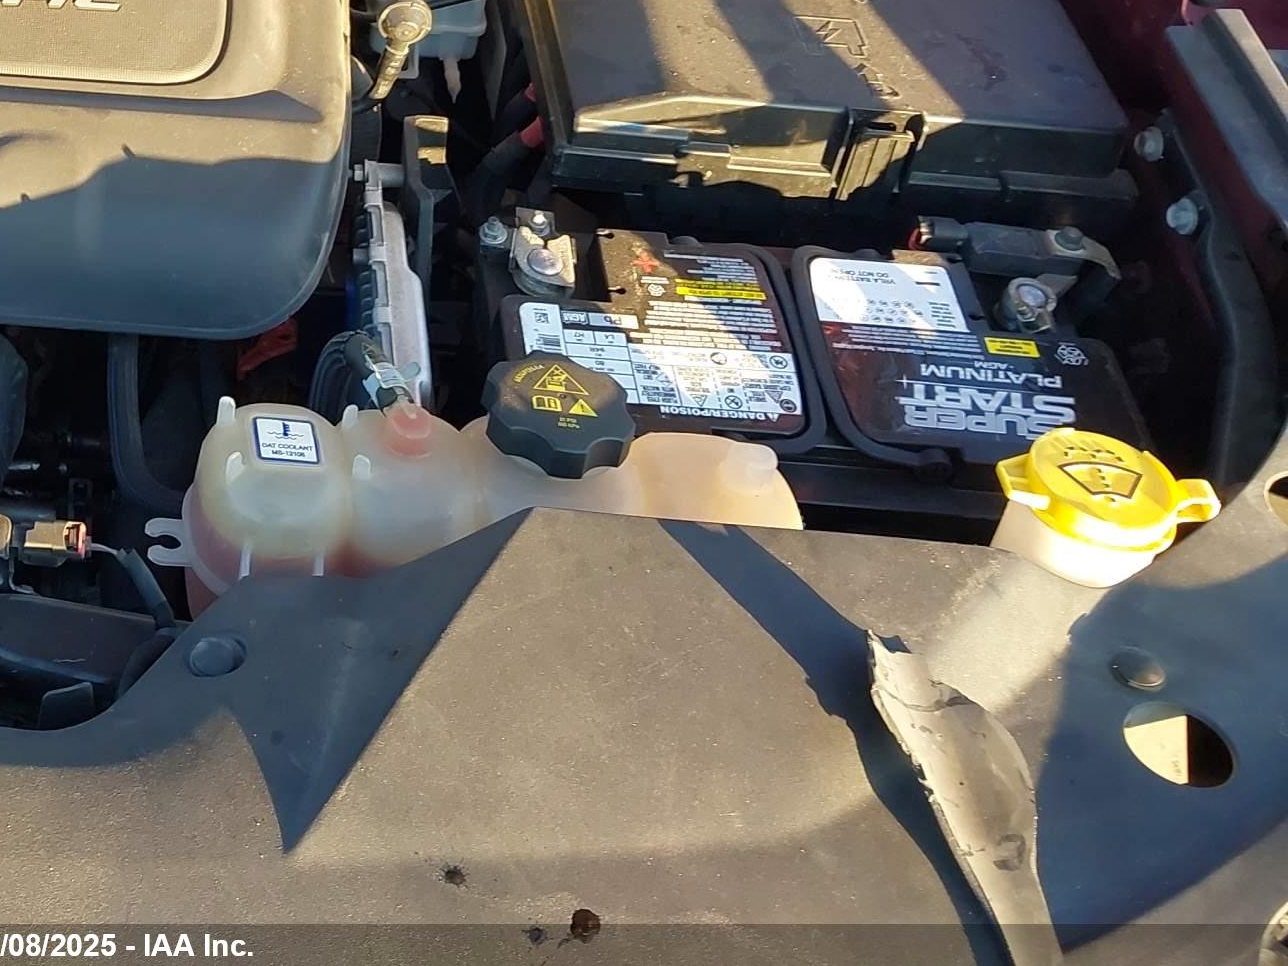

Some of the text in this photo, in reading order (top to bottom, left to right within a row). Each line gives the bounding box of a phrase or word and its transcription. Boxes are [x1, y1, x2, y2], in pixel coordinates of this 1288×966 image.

[604, 315, 622, 325] Pb
[920, 363, 1062, 388] PLATINUM
[659, 405, 766, 421] DANGER/POISON
[896, 384, 1076, 423] START
[904, 405, 1062, 440] SUPER
[277, 443, 313, 451] COOLANT
